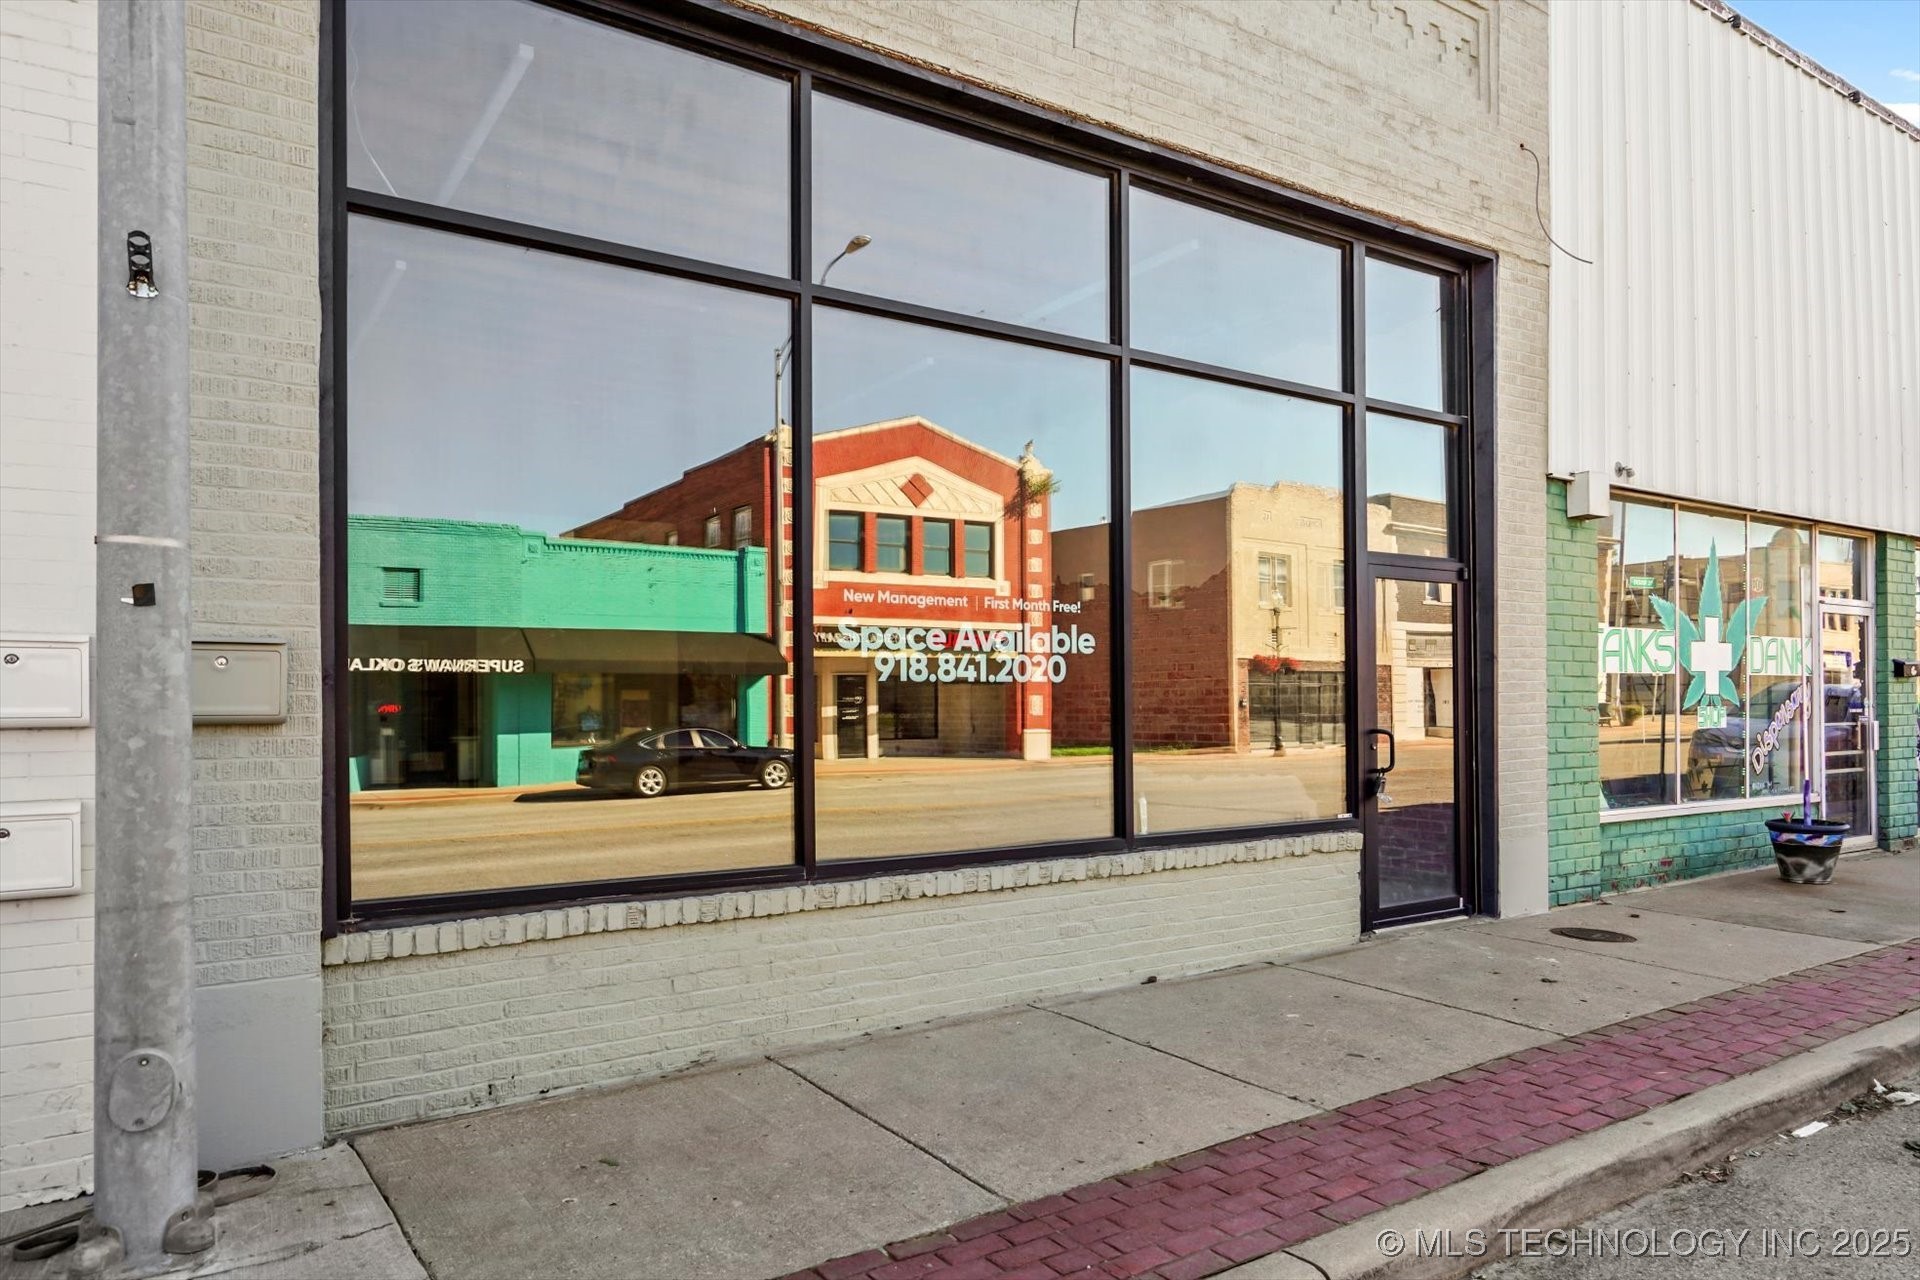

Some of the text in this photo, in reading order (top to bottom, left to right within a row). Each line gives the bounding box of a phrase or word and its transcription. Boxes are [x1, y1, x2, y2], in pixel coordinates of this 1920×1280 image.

[843, 588, 1081, 614] New Management First Month Free!
[837, 617, 947, 657] Space
[953, 622, 1096, 655] Available
[1598, 628, 1812, 675] ANKS DANK
[874, 651, 1067, 684] 918.841.2020
